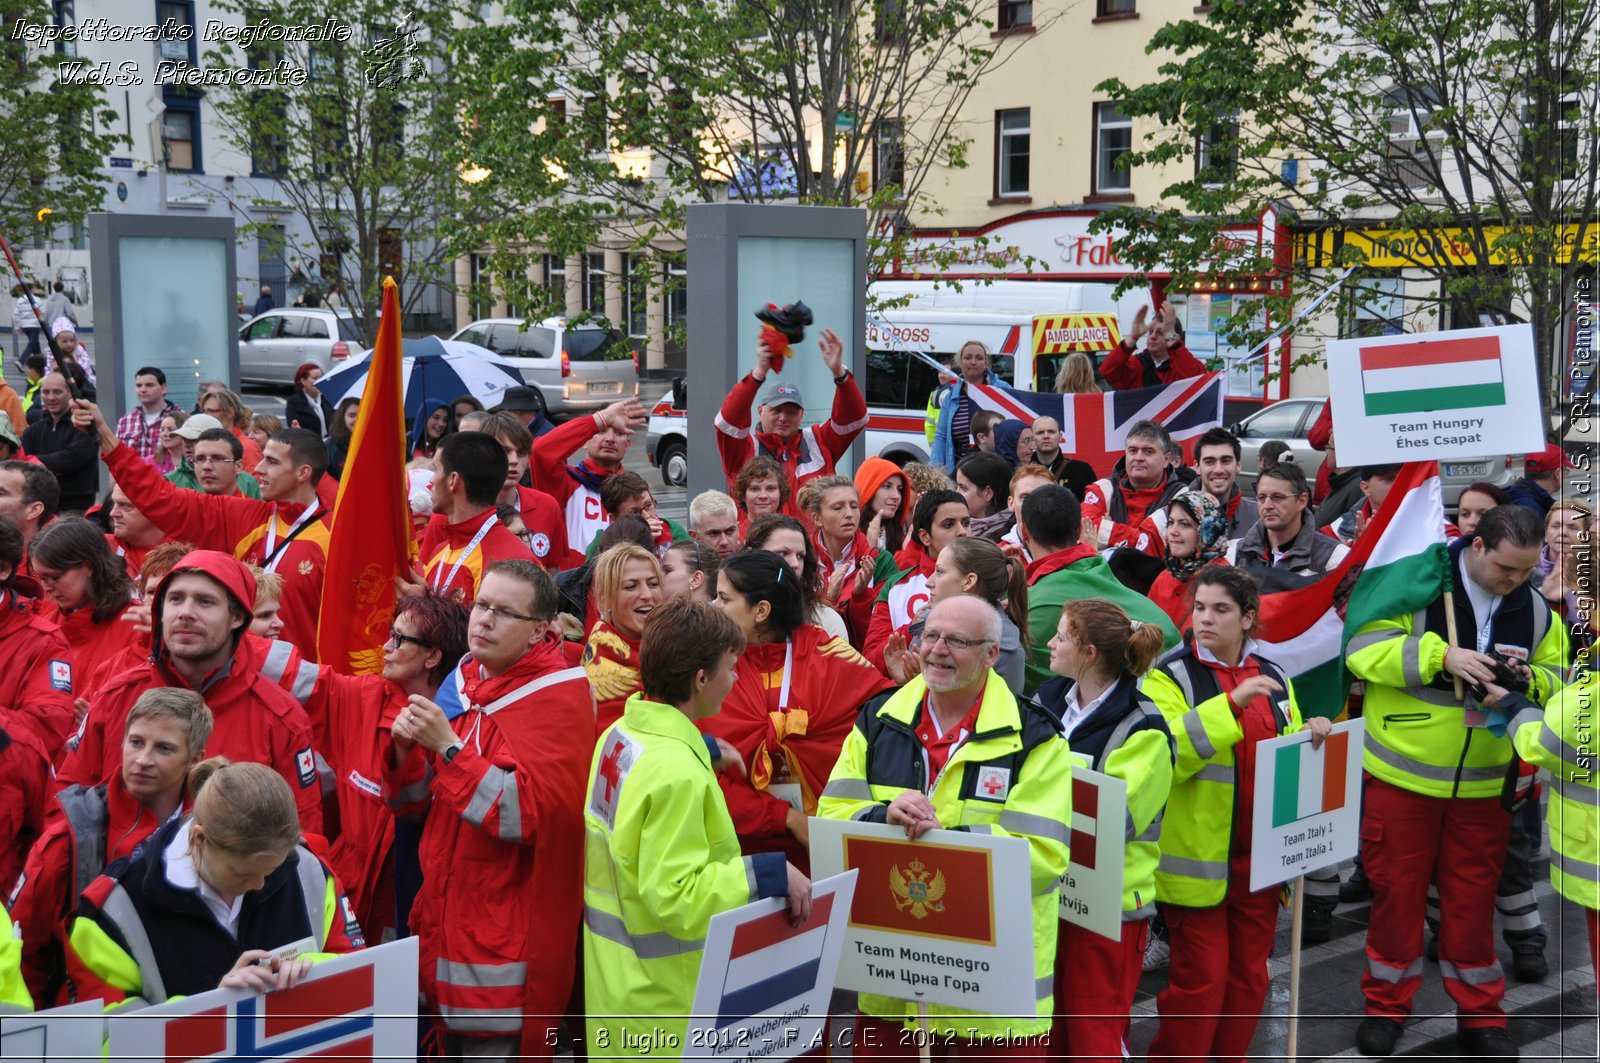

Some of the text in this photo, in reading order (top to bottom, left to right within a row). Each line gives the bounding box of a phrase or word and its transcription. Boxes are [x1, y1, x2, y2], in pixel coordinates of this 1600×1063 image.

[881, 327, 930, 342] CROSS
[1047, 328, 1108, 343] AMBULANCE
[1389, 418, 1484, 433] Team Hungry
[1396, 433, 1482, 448] Éhes Csapat
[1283, 821, 1333, 847] Team Italy 1
[1281, 840, 1333, 867] Team Italia 1
[854, 940, 990, 972] Team Montenegro
[866, 963, 980, 993] Тим Црна Гора
[747, 1003, 810, 1040] Netherlands
